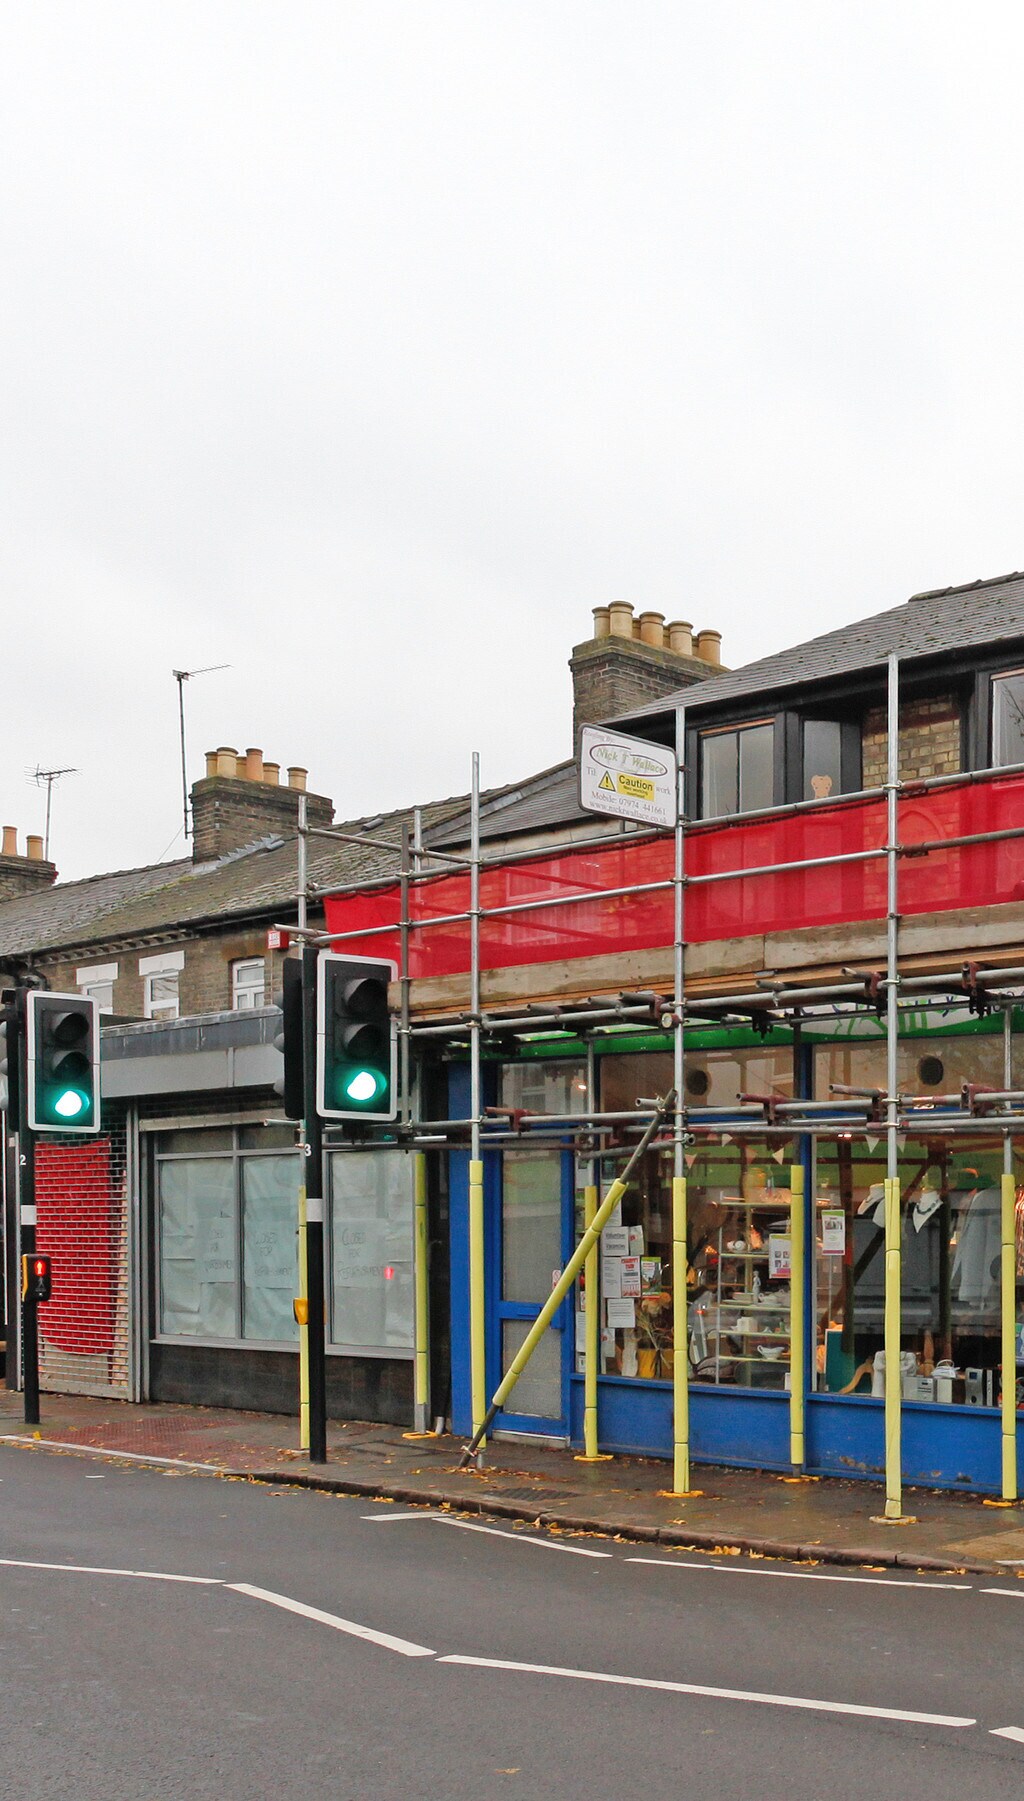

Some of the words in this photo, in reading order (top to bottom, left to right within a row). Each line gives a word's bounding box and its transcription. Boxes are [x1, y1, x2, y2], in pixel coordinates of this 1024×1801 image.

[618, 774, 653, 791] Caution
[304, 1143, 312, 1157] 3
[20, 1154, 27, 1166] 2
